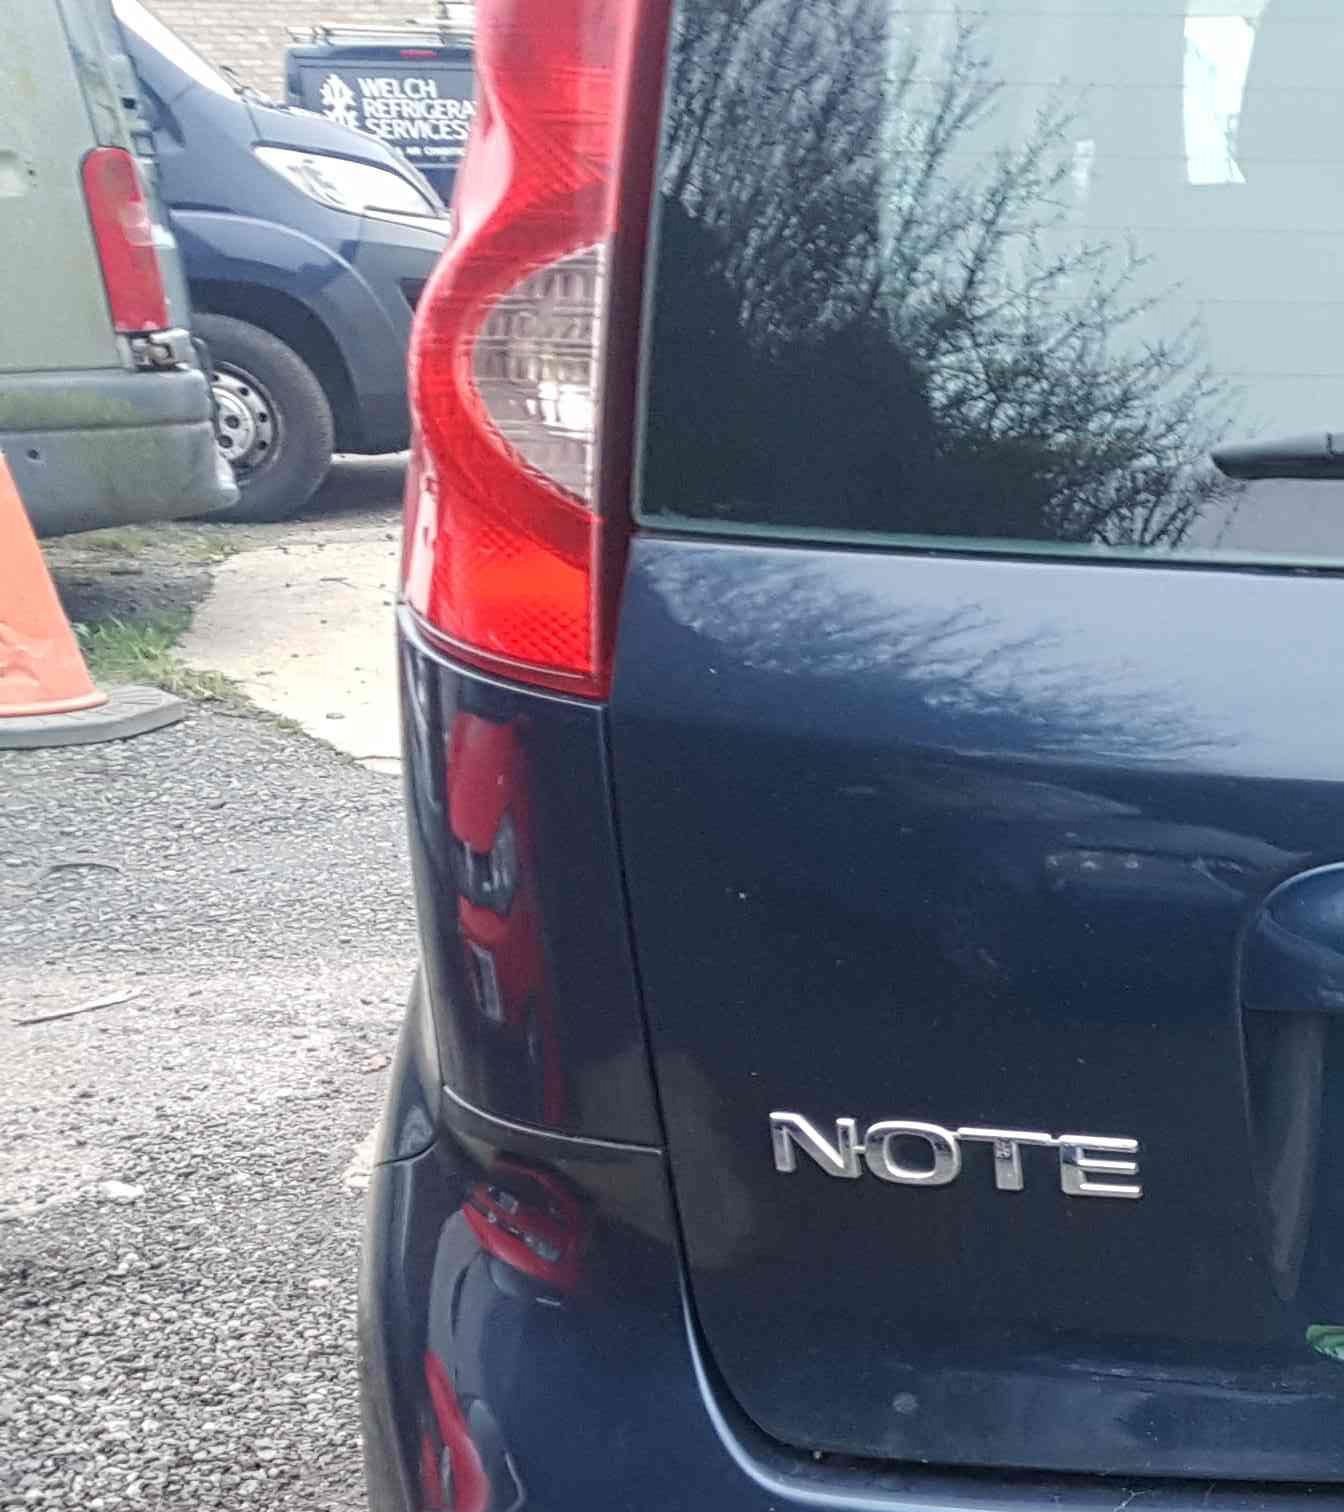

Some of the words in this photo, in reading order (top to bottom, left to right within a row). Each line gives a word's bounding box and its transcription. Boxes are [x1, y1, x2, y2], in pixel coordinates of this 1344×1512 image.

[357, 78, 438, 98] WELCH
[361, 98, 477, 119] REFRIGERA
[363, 118, 470, 140] SERVICES
[769, 1111, 1143, 1199] NOTE
